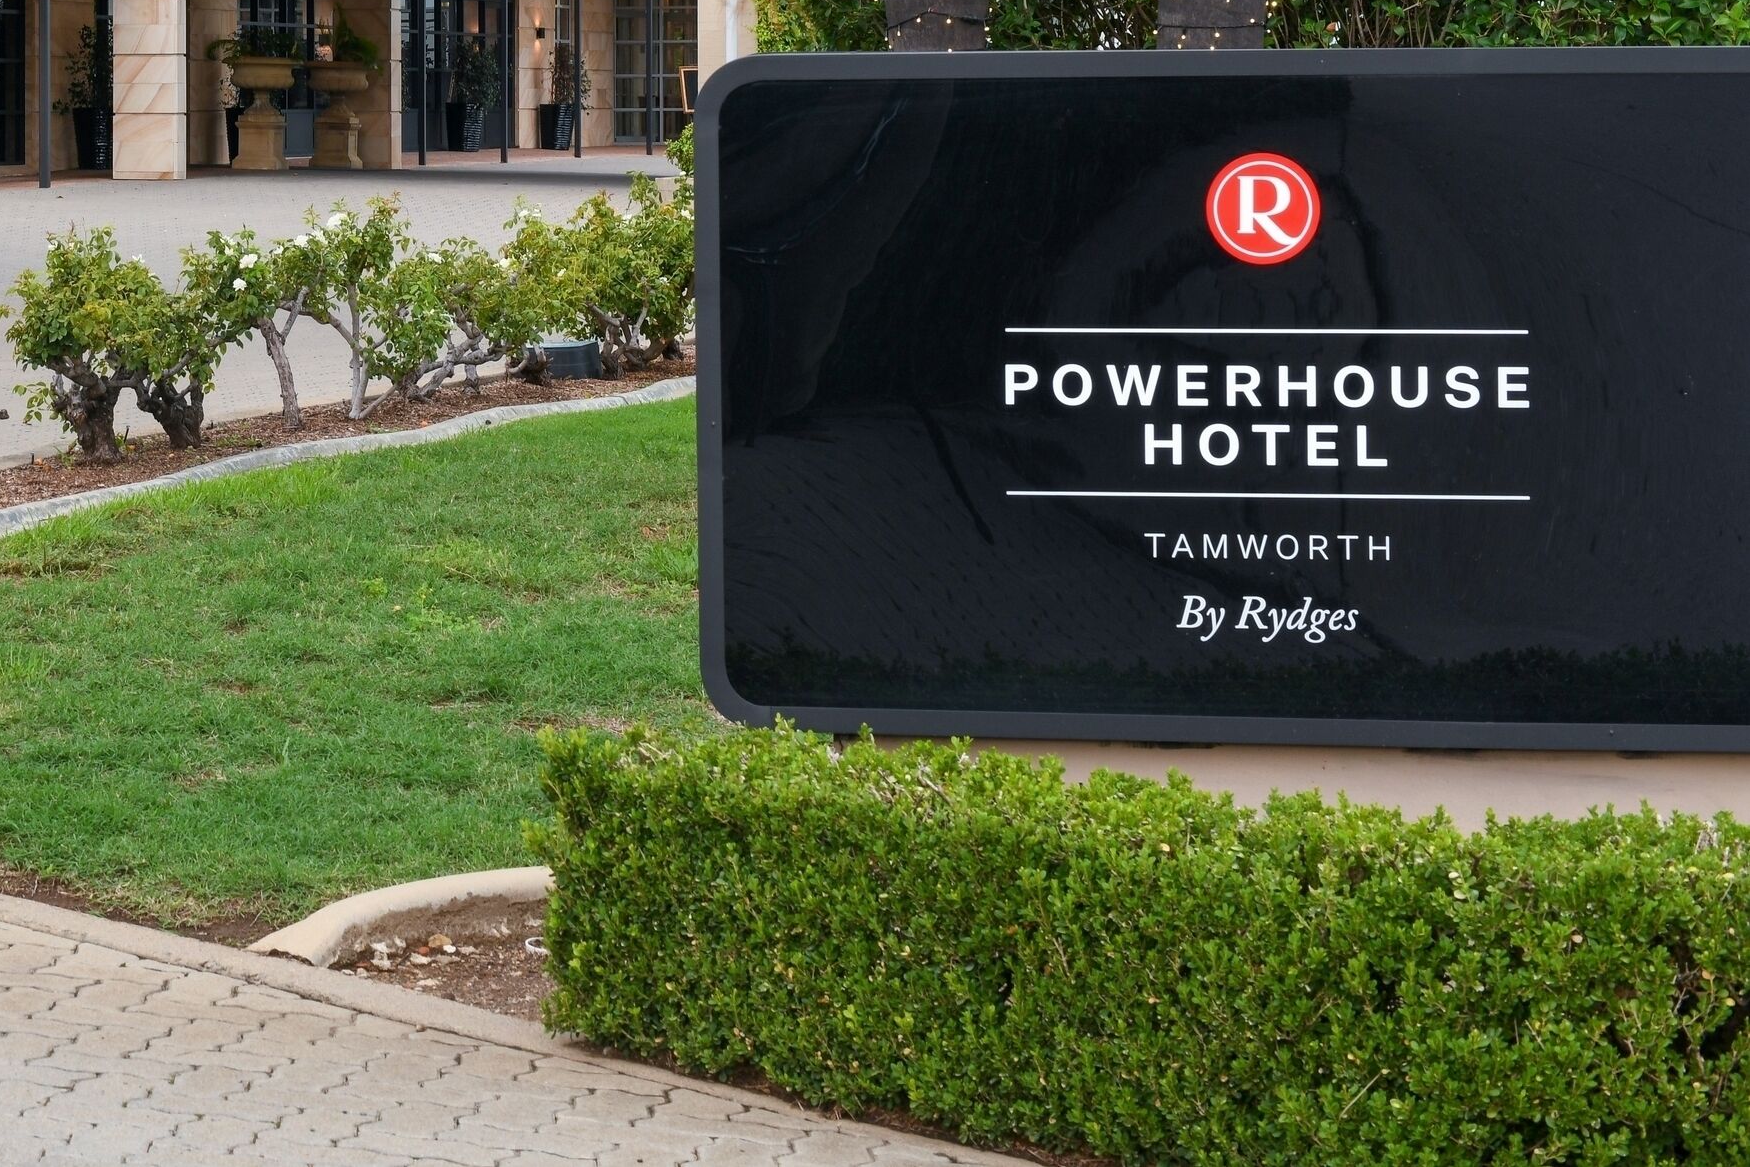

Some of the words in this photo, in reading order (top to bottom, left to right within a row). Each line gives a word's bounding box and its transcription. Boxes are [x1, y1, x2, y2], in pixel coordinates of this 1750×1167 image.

[1236, 175, 1302, 246] R
[1003, 362, 1531, 410] POWERHOUSE
[1143, 422, 1389, 468] HOTEL
[1142, 531, 1391, 562] TAMWORTH
[1175, 595, 1226, 642] By
[1233, 595, 1359, 644] Rydges
